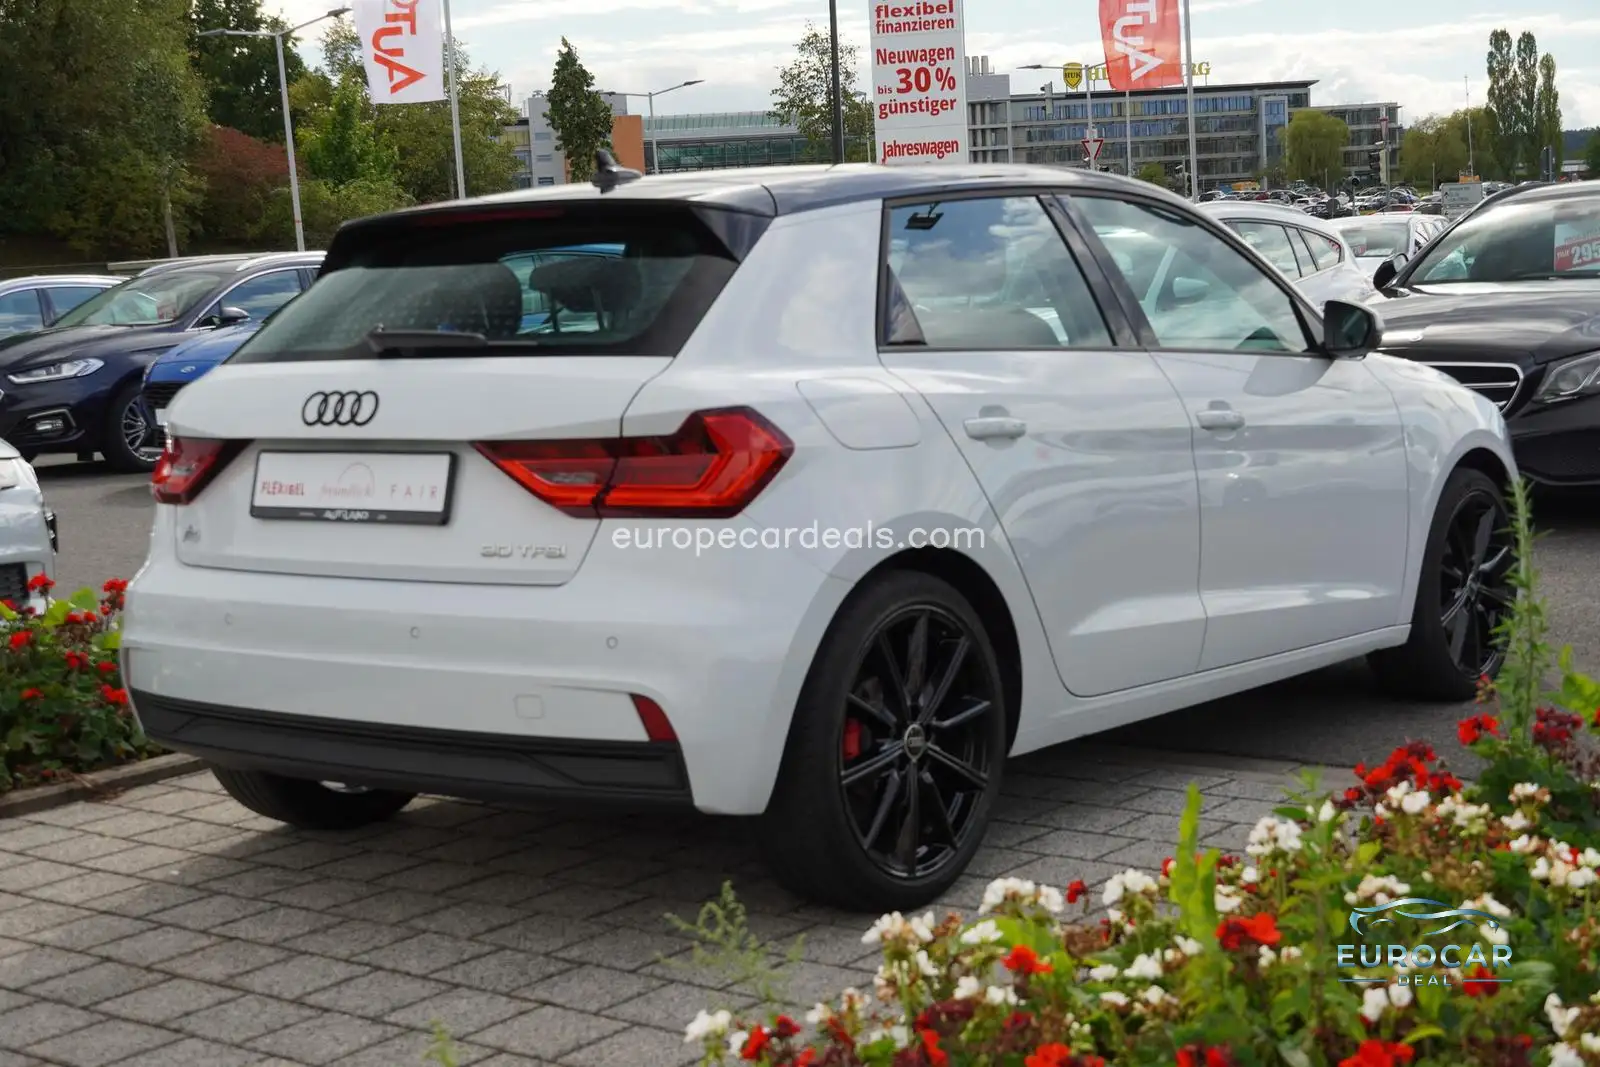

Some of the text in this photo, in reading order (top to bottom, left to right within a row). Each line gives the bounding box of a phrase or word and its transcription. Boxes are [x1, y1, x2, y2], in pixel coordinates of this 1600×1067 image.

[875, 0, 954, 18] flexibel
[876, 17, 954, 34] finanzieren
[876, 46, 955, 66] Neuwagen
[1064, 71, 1082, 79] HUK
[877, 85, 893, 95] bis
[878, 97, 957, 119] günstiger
[881, 139, 959, 165] Jahreswagen
[261, 479, 305, 496] FLEXIBEL
